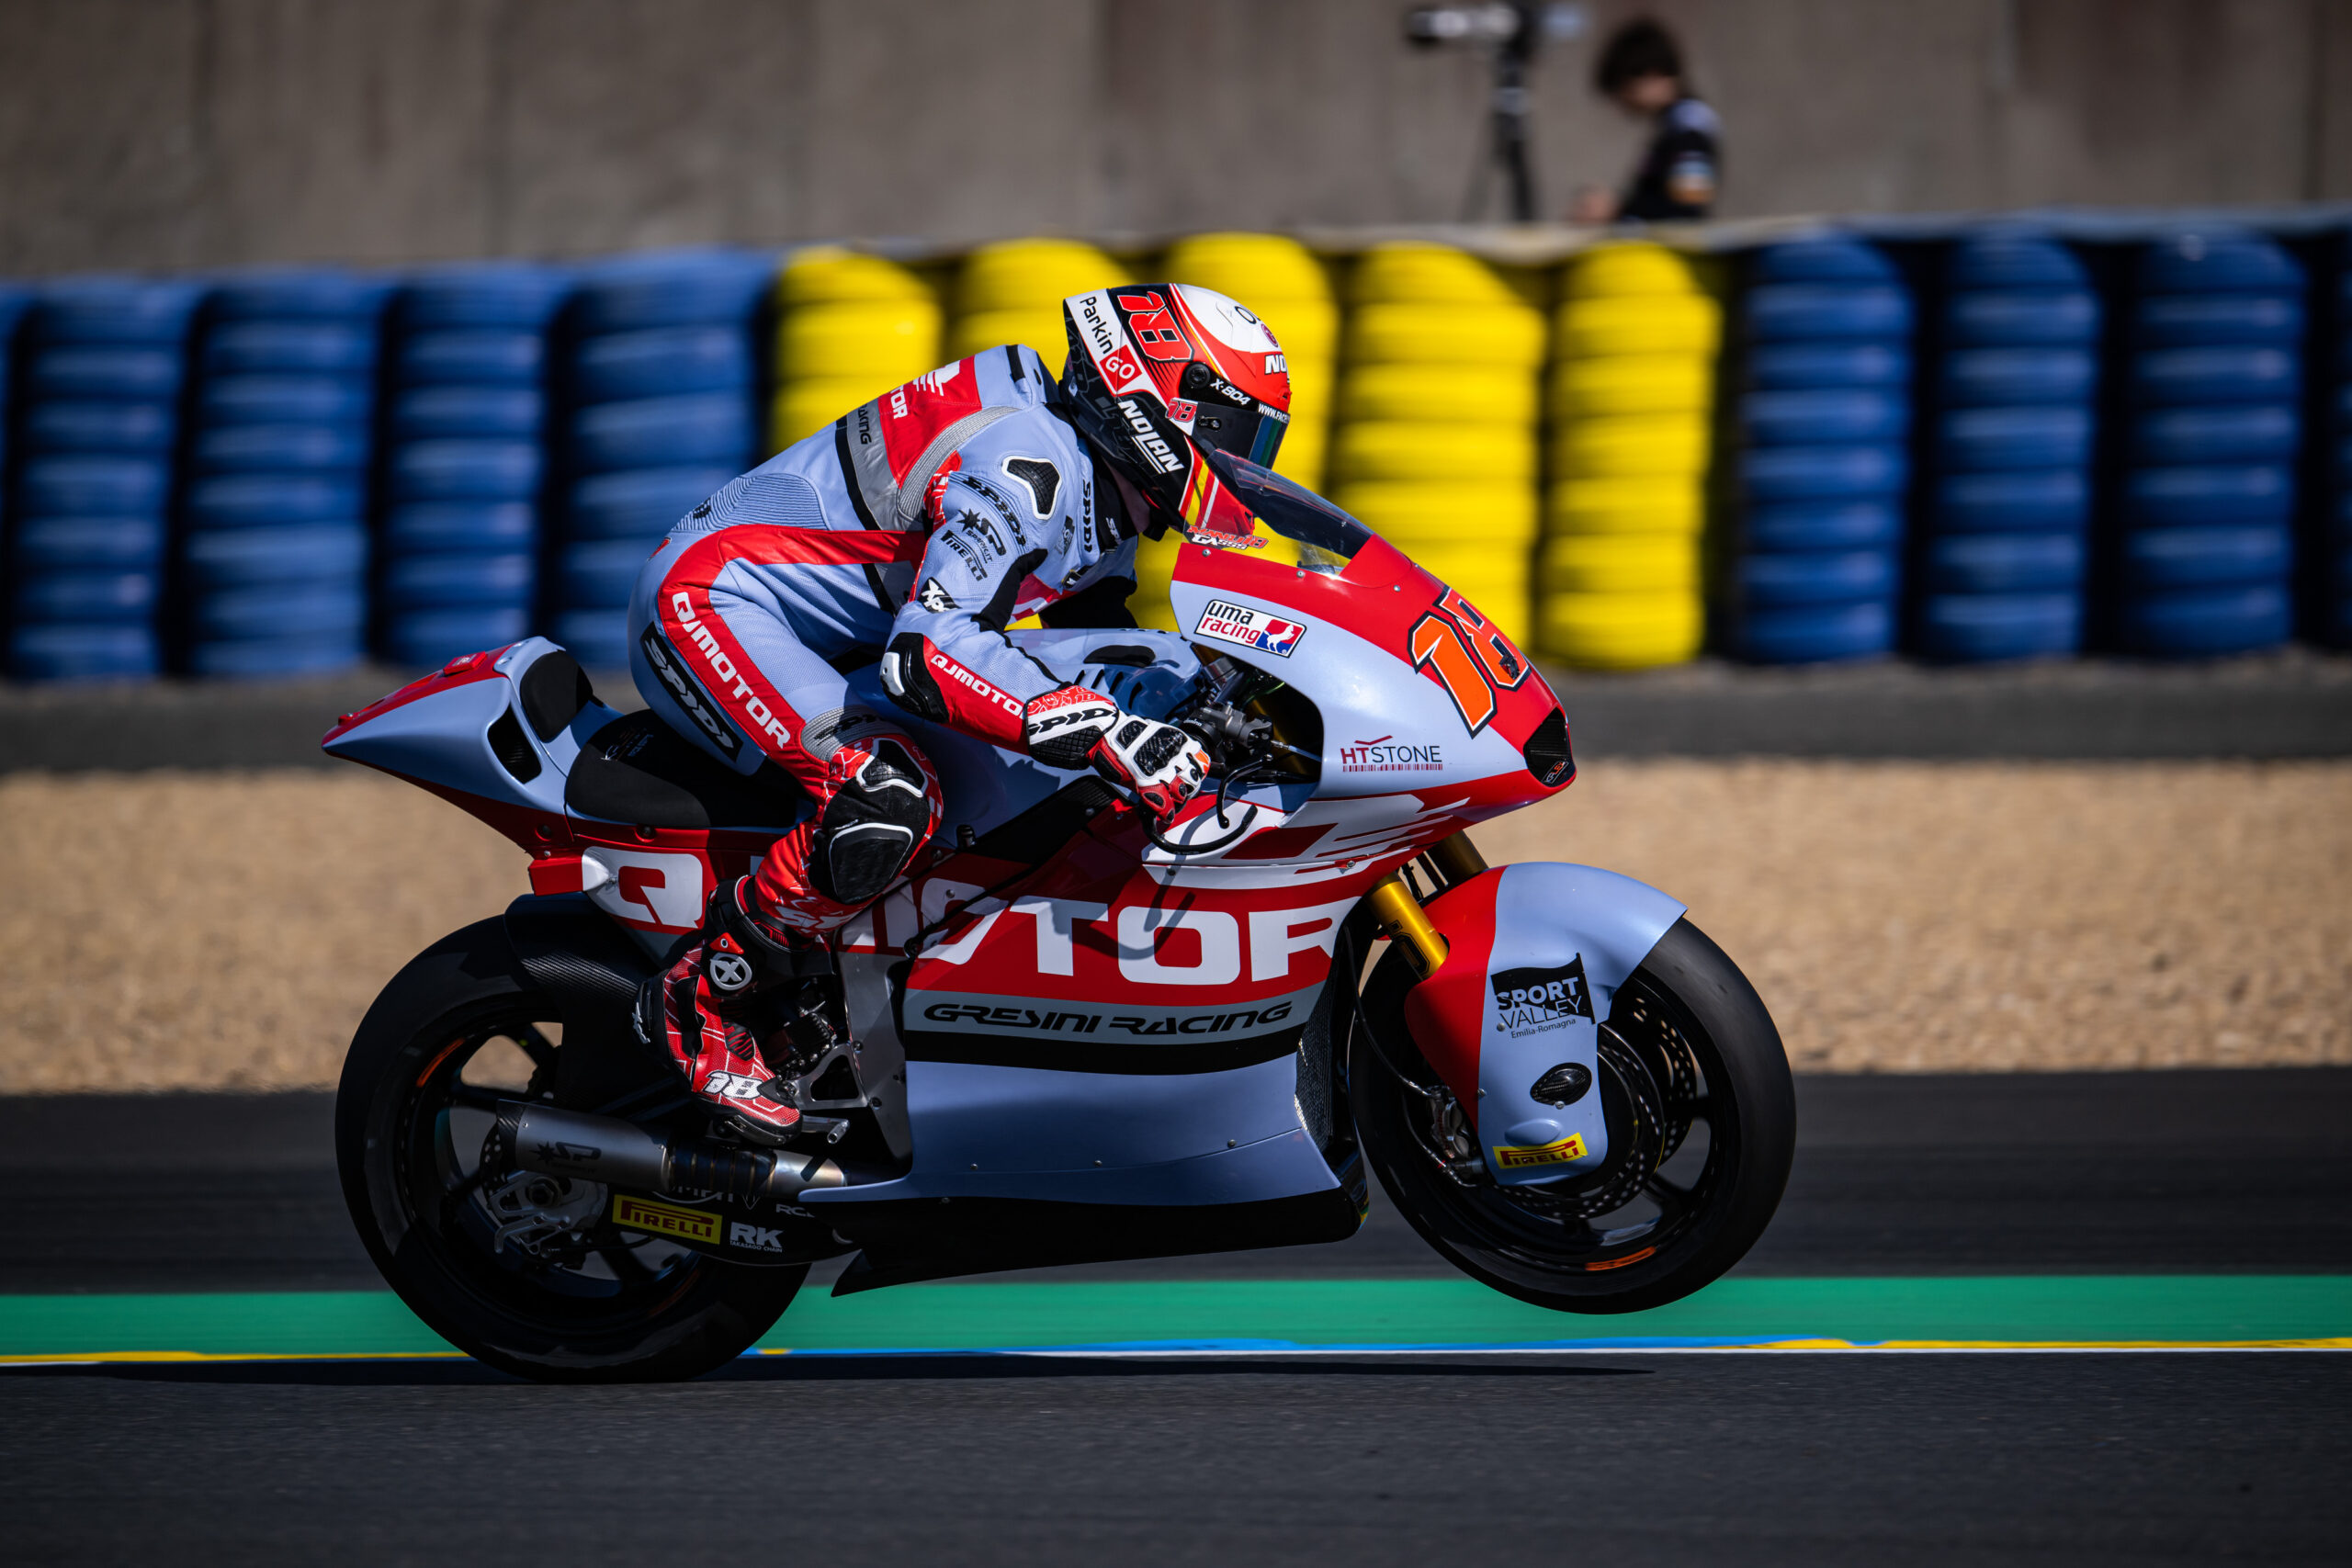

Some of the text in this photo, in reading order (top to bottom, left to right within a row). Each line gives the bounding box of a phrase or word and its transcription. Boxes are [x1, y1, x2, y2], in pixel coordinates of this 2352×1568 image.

[1117, 400, 1184, 473] NOLAN
[940, 529, 988, 581] PIRELLI
[1201, 615, 1261, 644] racing
[1207, 603, 1254, 626] uma
[673, 592, 791, 749] QJMOTOR
[1407, 584, 1532, 740] 18
[645, 637, 734, 749] SPIDI
[930, 654, 1025, 720] QJMOTO
[1340, 745, 1442, 764] HTSTONE
[1497, 976, 1579, 1010] SPORT
[923, 1000, 1293, 1035] GRESINI RACING
[1499, 995, 1583, 1030] VALLEY
[1510, 1018, 1577, 1039] Emilia-Romagna
[701, 1069, 764, 1100] 18
[1500, 1139, 1579, 1166] PIRELLI
[620, 1200, 714, 1238] PIRELLI
[729, 1222, 785, 1248] RK
